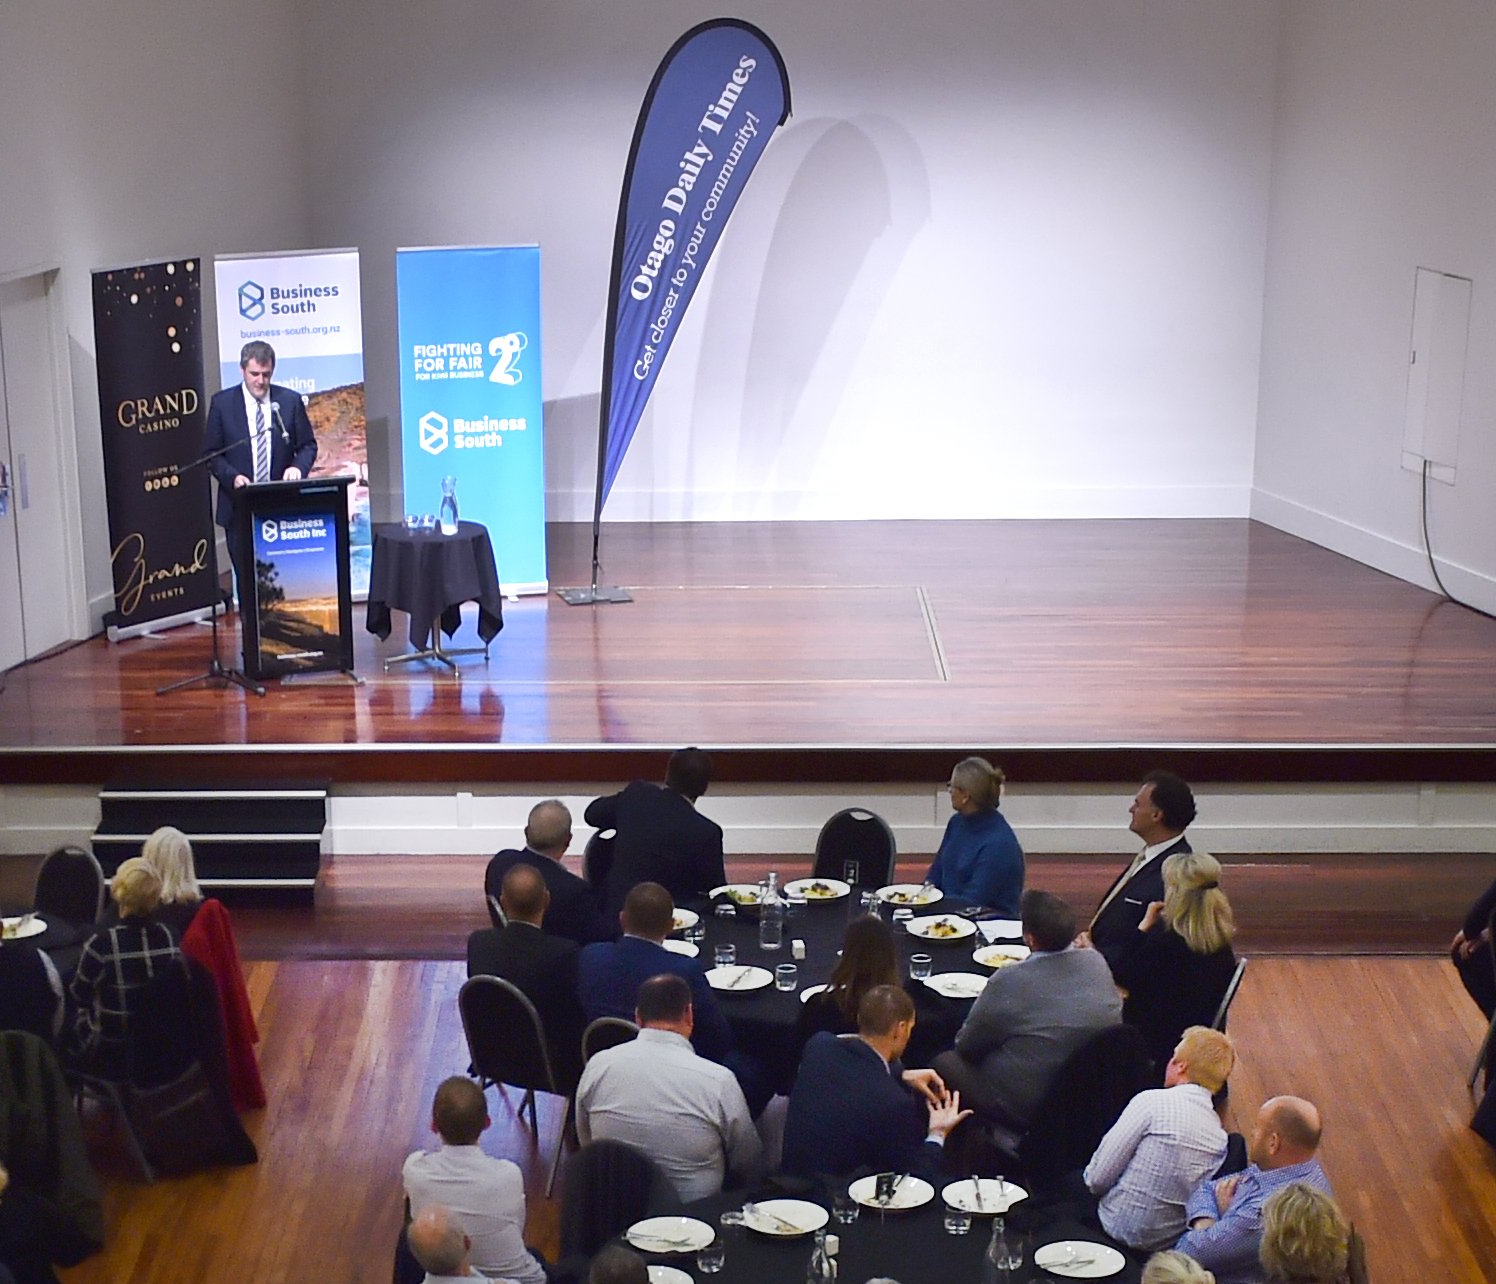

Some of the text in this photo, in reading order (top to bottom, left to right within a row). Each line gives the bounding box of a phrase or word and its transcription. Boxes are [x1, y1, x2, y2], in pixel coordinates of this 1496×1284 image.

[630, 55, 758, 301] Otago Daily Times
[633, 111, 761, 381] Get closer to your community!
[270, 284, 340, 300] Business
[271, 300, 317, 315] South
[240, 325, 342, 339] business-south.org.nz
[413, 342, 483, 358] FIGHTING
[414, 356, 483, 372] FOR FAIR
[117, 388, 198, 428] GRAND
[138, 418, 180, 434] CASINO
[453, 415, 527, 433] Business
[454, 432, 503, 449] South
[280, 529, 311, 541] South
[111, 532, 208, 616] Grand
[150, 587, 185, 602] EVENTS
